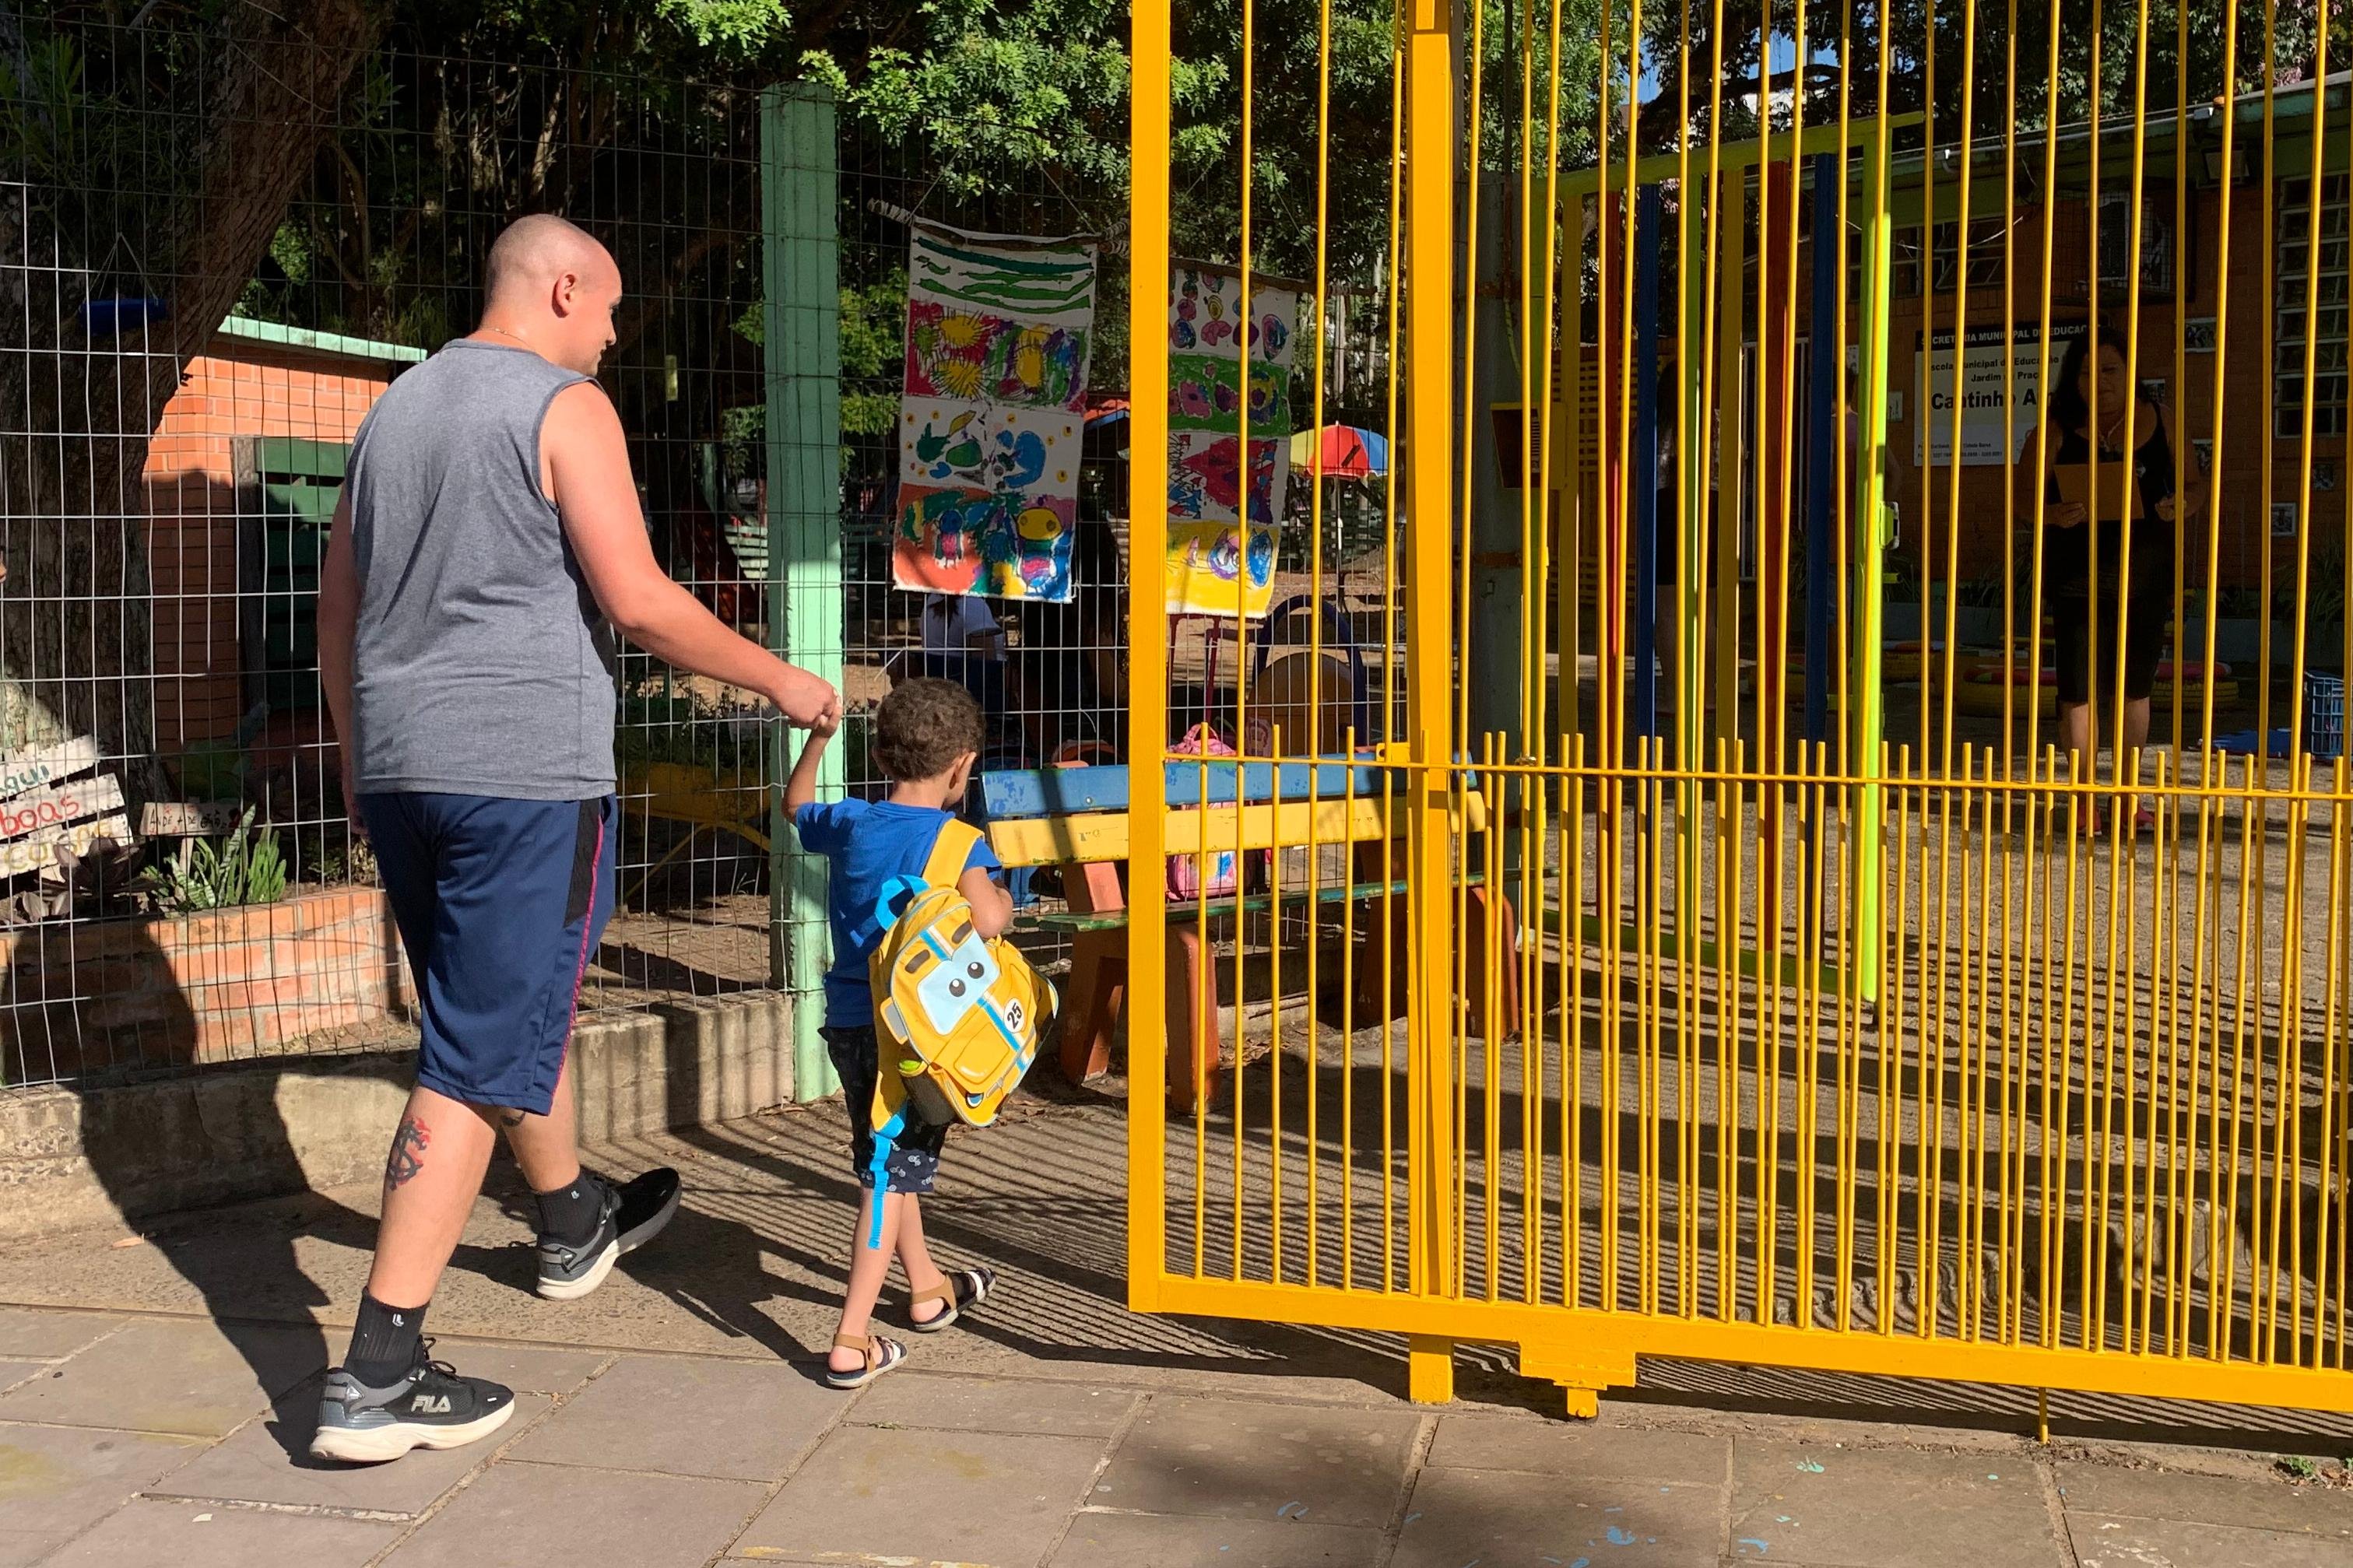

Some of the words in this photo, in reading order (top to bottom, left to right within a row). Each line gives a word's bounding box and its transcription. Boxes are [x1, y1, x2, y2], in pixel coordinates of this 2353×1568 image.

[1920, 333, 1976, 345] CRETIA
[1979, 329, 2030, 341] MUNIPAL
[1930, 362, 1953, 371] scola
[1963, 358, 1997, 370] unicipal
[1971, 373, 2001, 382] Jardim
[2018, 371, 2039, 381] Praç
[1931, 390, 2016, 409] Catinh
[0, 765, 49, 793] qui
[0, 795, 79, 835] boas
[1007, 1002, 1022, 1030] 25
[410, 1394, 451, 1413] FILA
